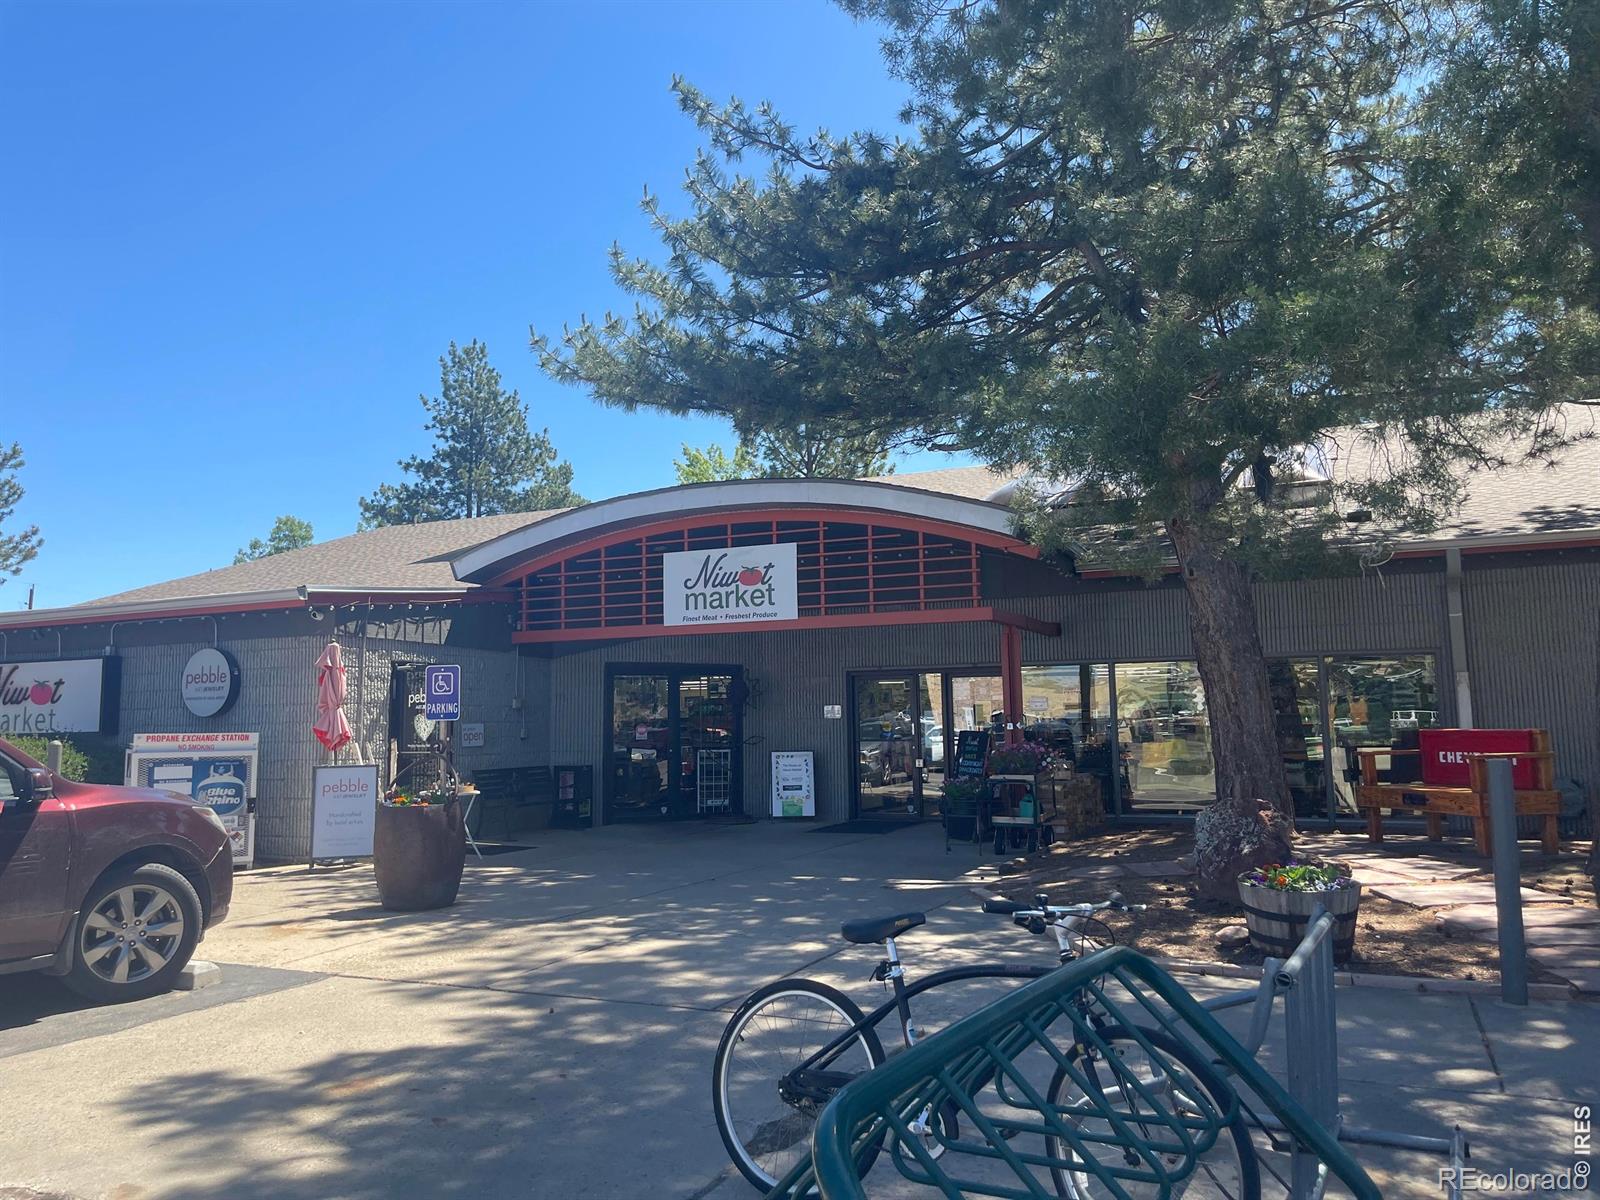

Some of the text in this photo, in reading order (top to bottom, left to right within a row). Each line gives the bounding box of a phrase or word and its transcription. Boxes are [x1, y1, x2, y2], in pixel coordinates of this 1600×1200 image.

[685, 583, 776, 611] market
[752, 611, 778, 619] Produce
[186, 663, 227, 689] pebble
[408, 687, 427, 708] peb
[427, 702, 458, 714] PARKING
[0, 706, 56, 733] arket
[146, 734, 250, 743] PROPANE EXCHANGE STATION
[464, 732, 484, 745] open
[207, 787, 236, 796] Blue
[322, 776, 369, 797] pebble
